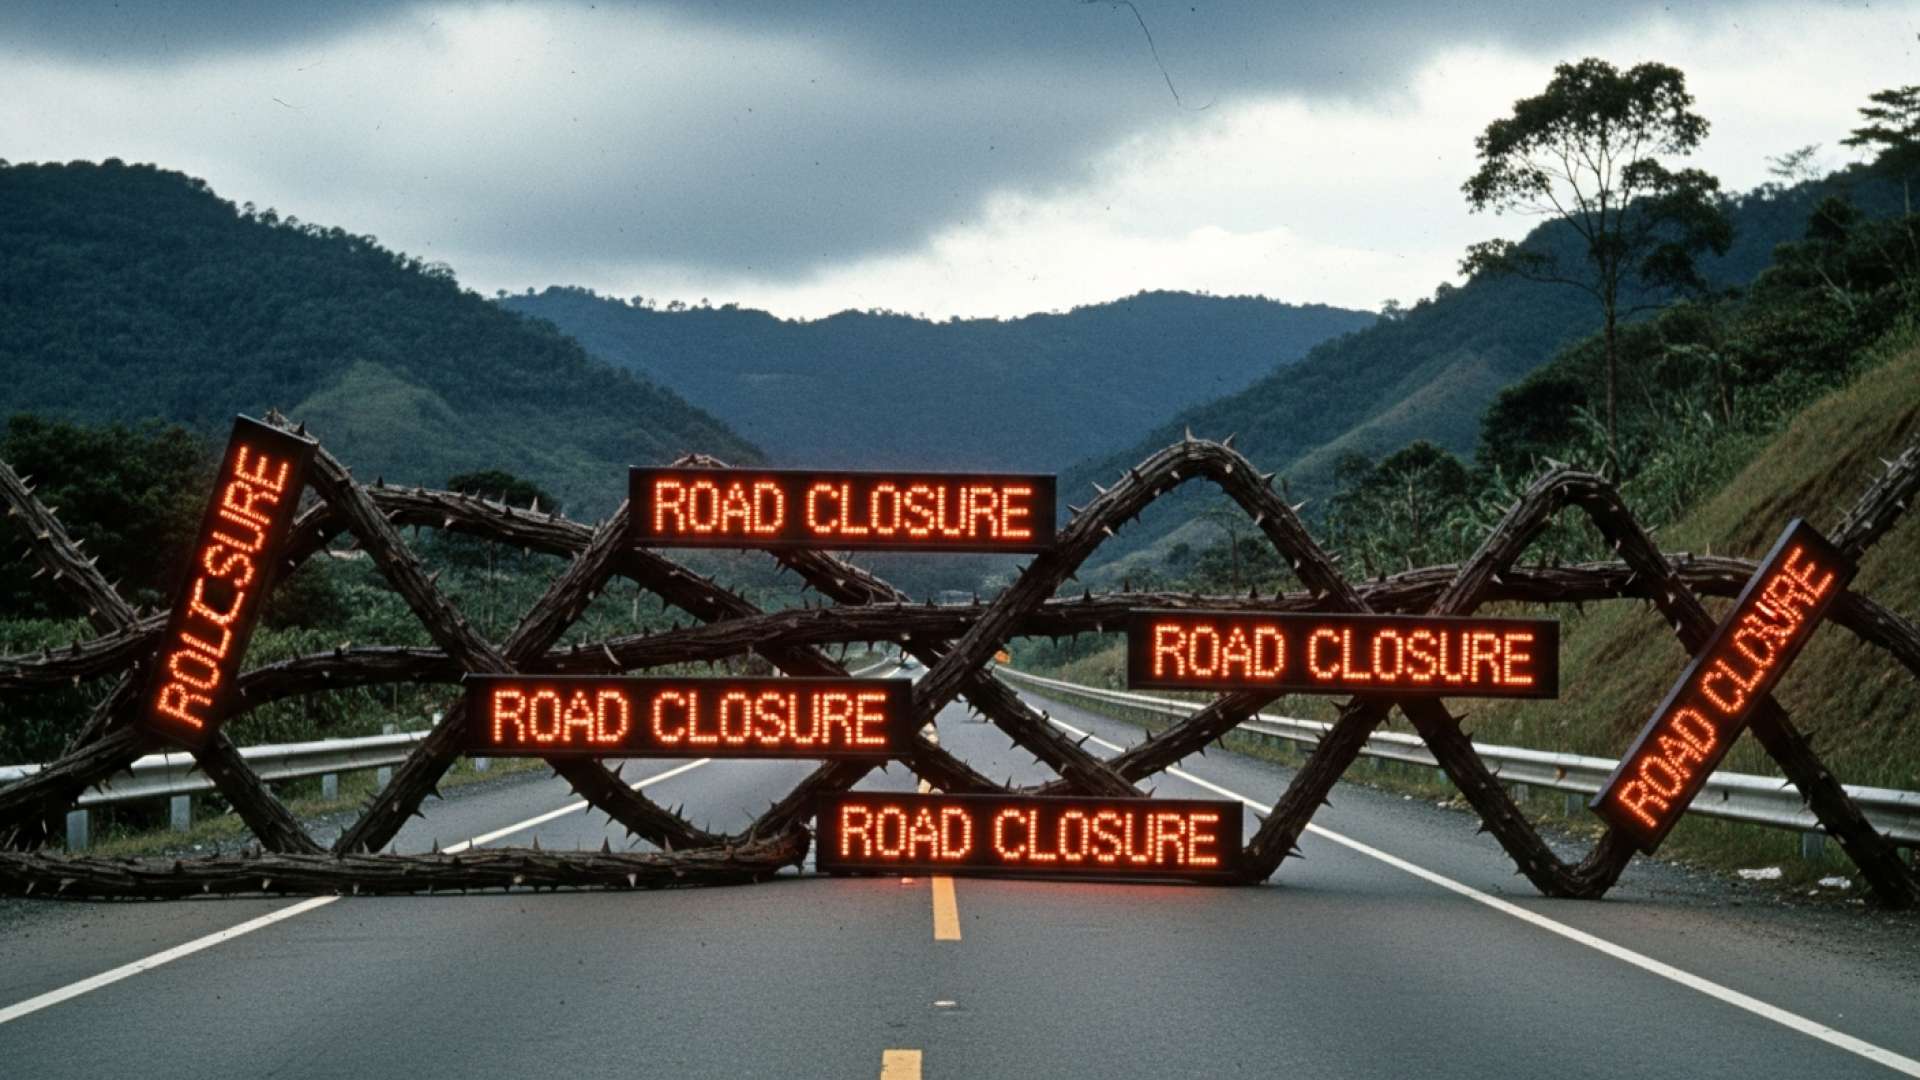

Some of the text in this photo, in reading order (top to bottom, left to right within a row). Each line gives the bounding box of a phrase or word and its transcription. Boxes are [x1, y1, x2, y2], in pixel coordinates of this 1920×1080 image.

[654, 479, 1031, 538] ROAD CLOSURE
[1154, 623, 1533, 684] ROAD CLOSURE
[493, 688, 885, 744] ROAD CLOSURE
[1618, 709, 1716, 827] ROAD
[841, 805, 1218, 865] ROAD CLOSURE
